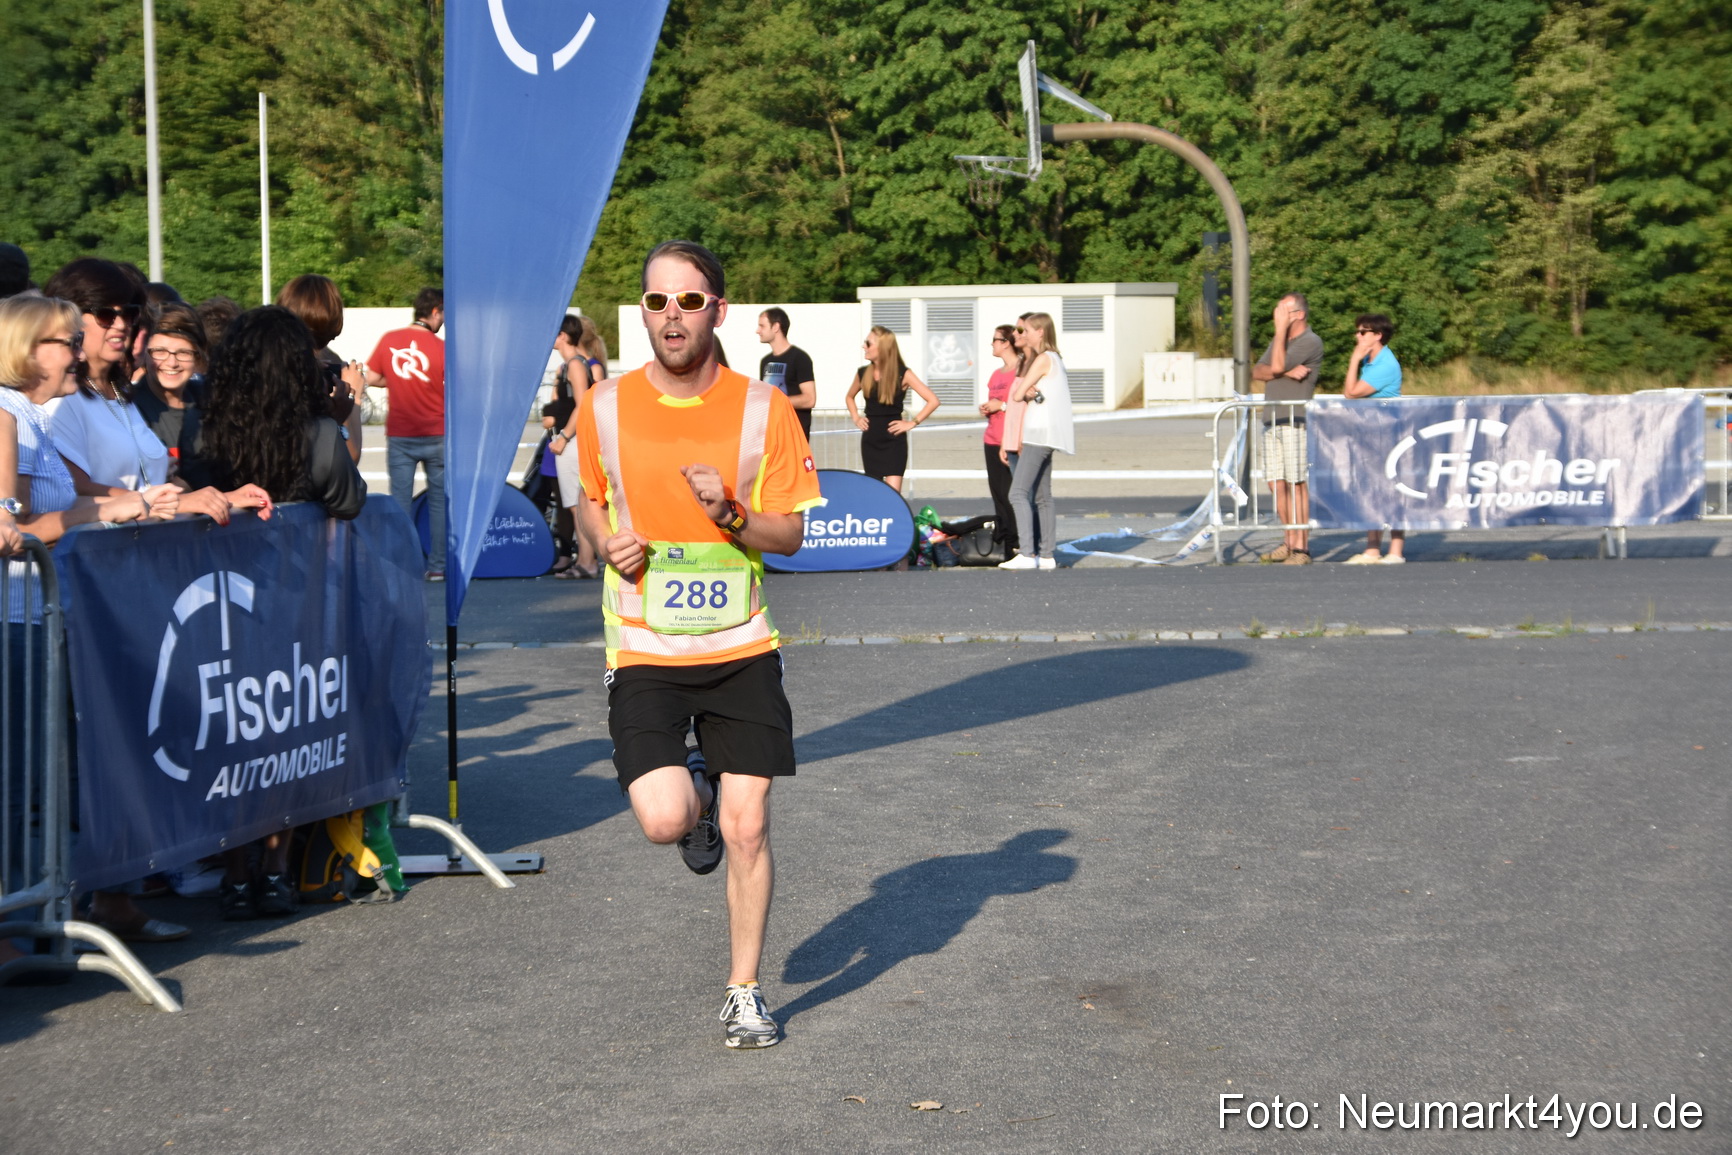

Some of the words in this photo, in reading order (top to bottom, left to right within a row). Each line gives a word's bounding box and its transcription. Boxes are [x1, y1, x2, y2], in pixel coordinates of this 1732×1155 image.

[1427, 450, 1621, 488] Fischer
[1445, 491, 1605, 509] AUTOMOBILE
[804, 513, 894, 536] ischer
[801, 536, 888, 549] AUTOMOBILE
[664, 580, 728, 609] 288
[205, 732, 347, 801] AUTOMOBILE
